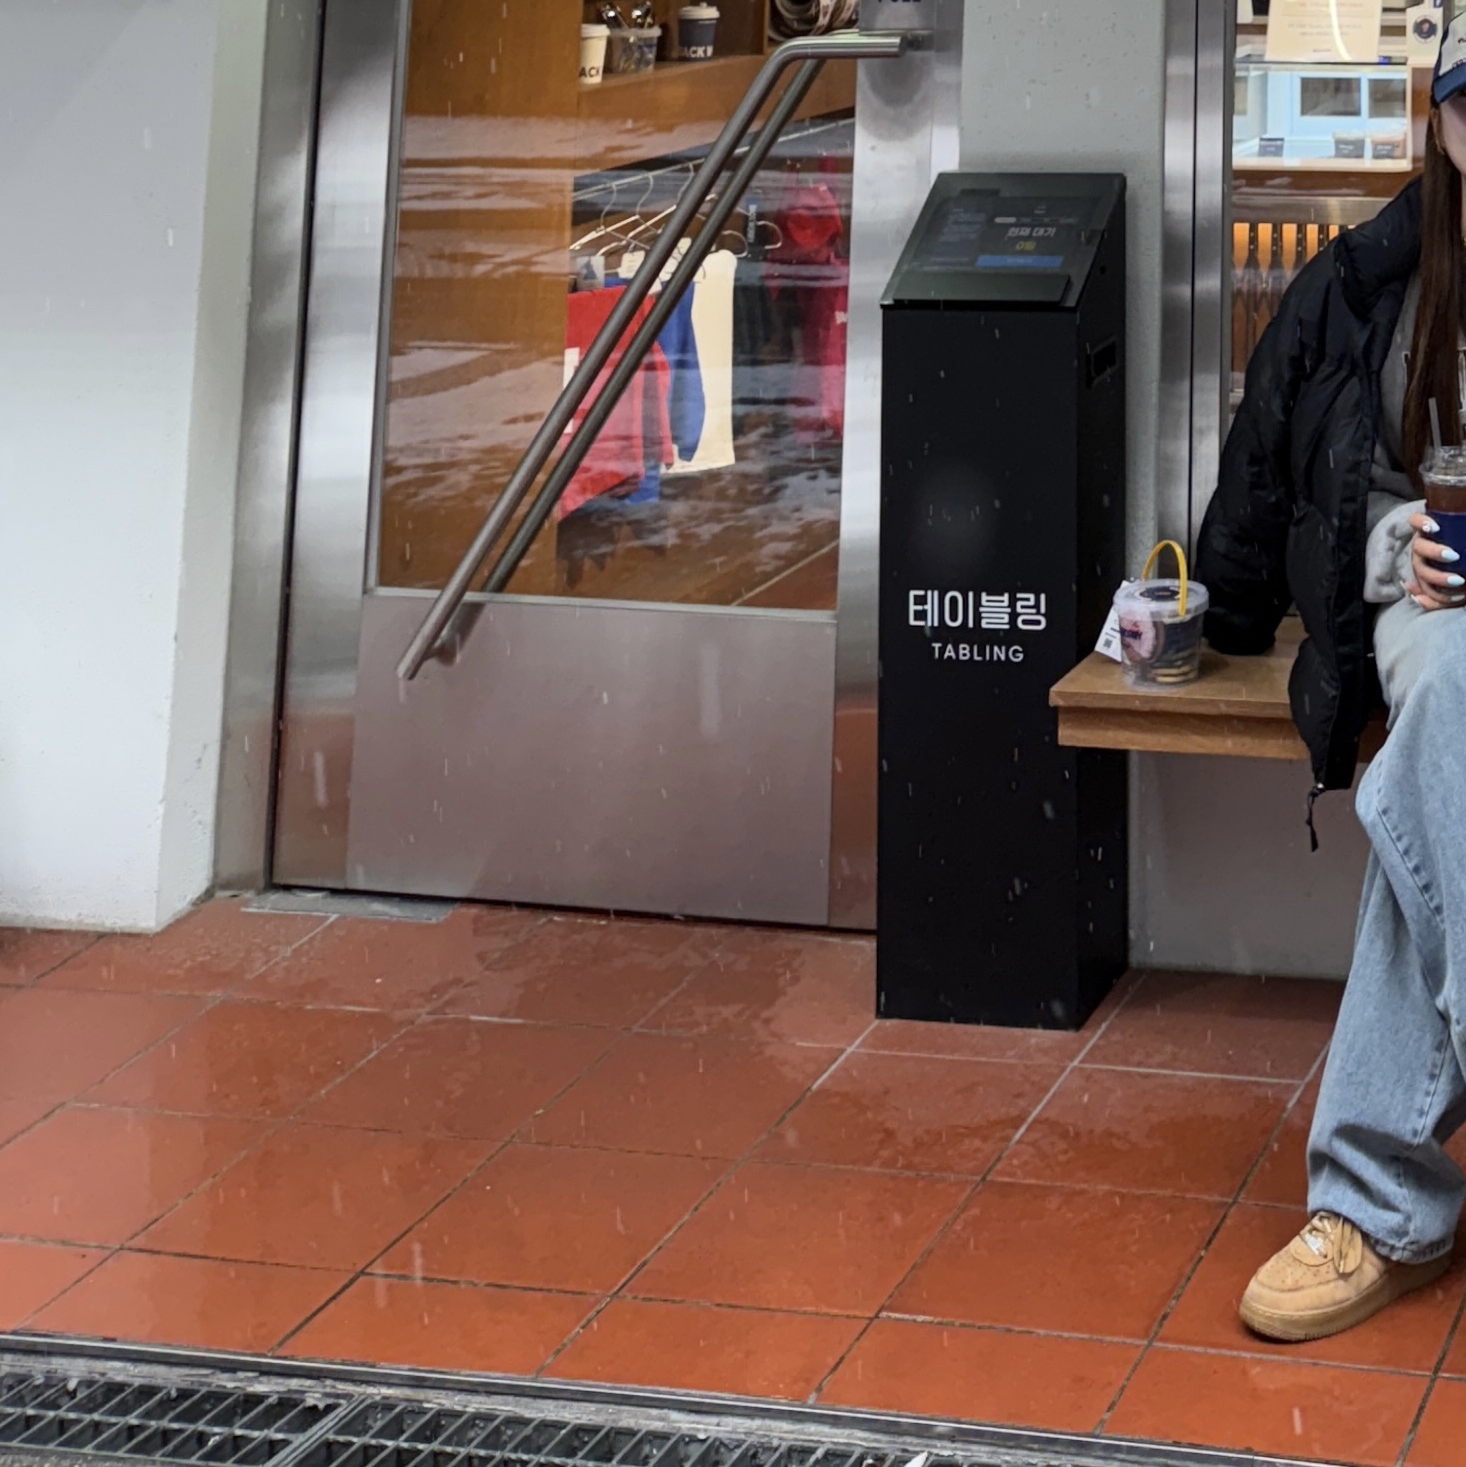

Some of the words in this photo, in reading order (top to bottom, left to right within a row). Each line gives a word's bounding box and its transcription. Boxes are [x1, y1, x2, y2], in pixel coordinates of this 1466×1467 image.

[1032, 227, 1056, 237] 대기
[908, 589, 1048, 631] 테이블링
[932, 642, 1024, 663] TABLING
